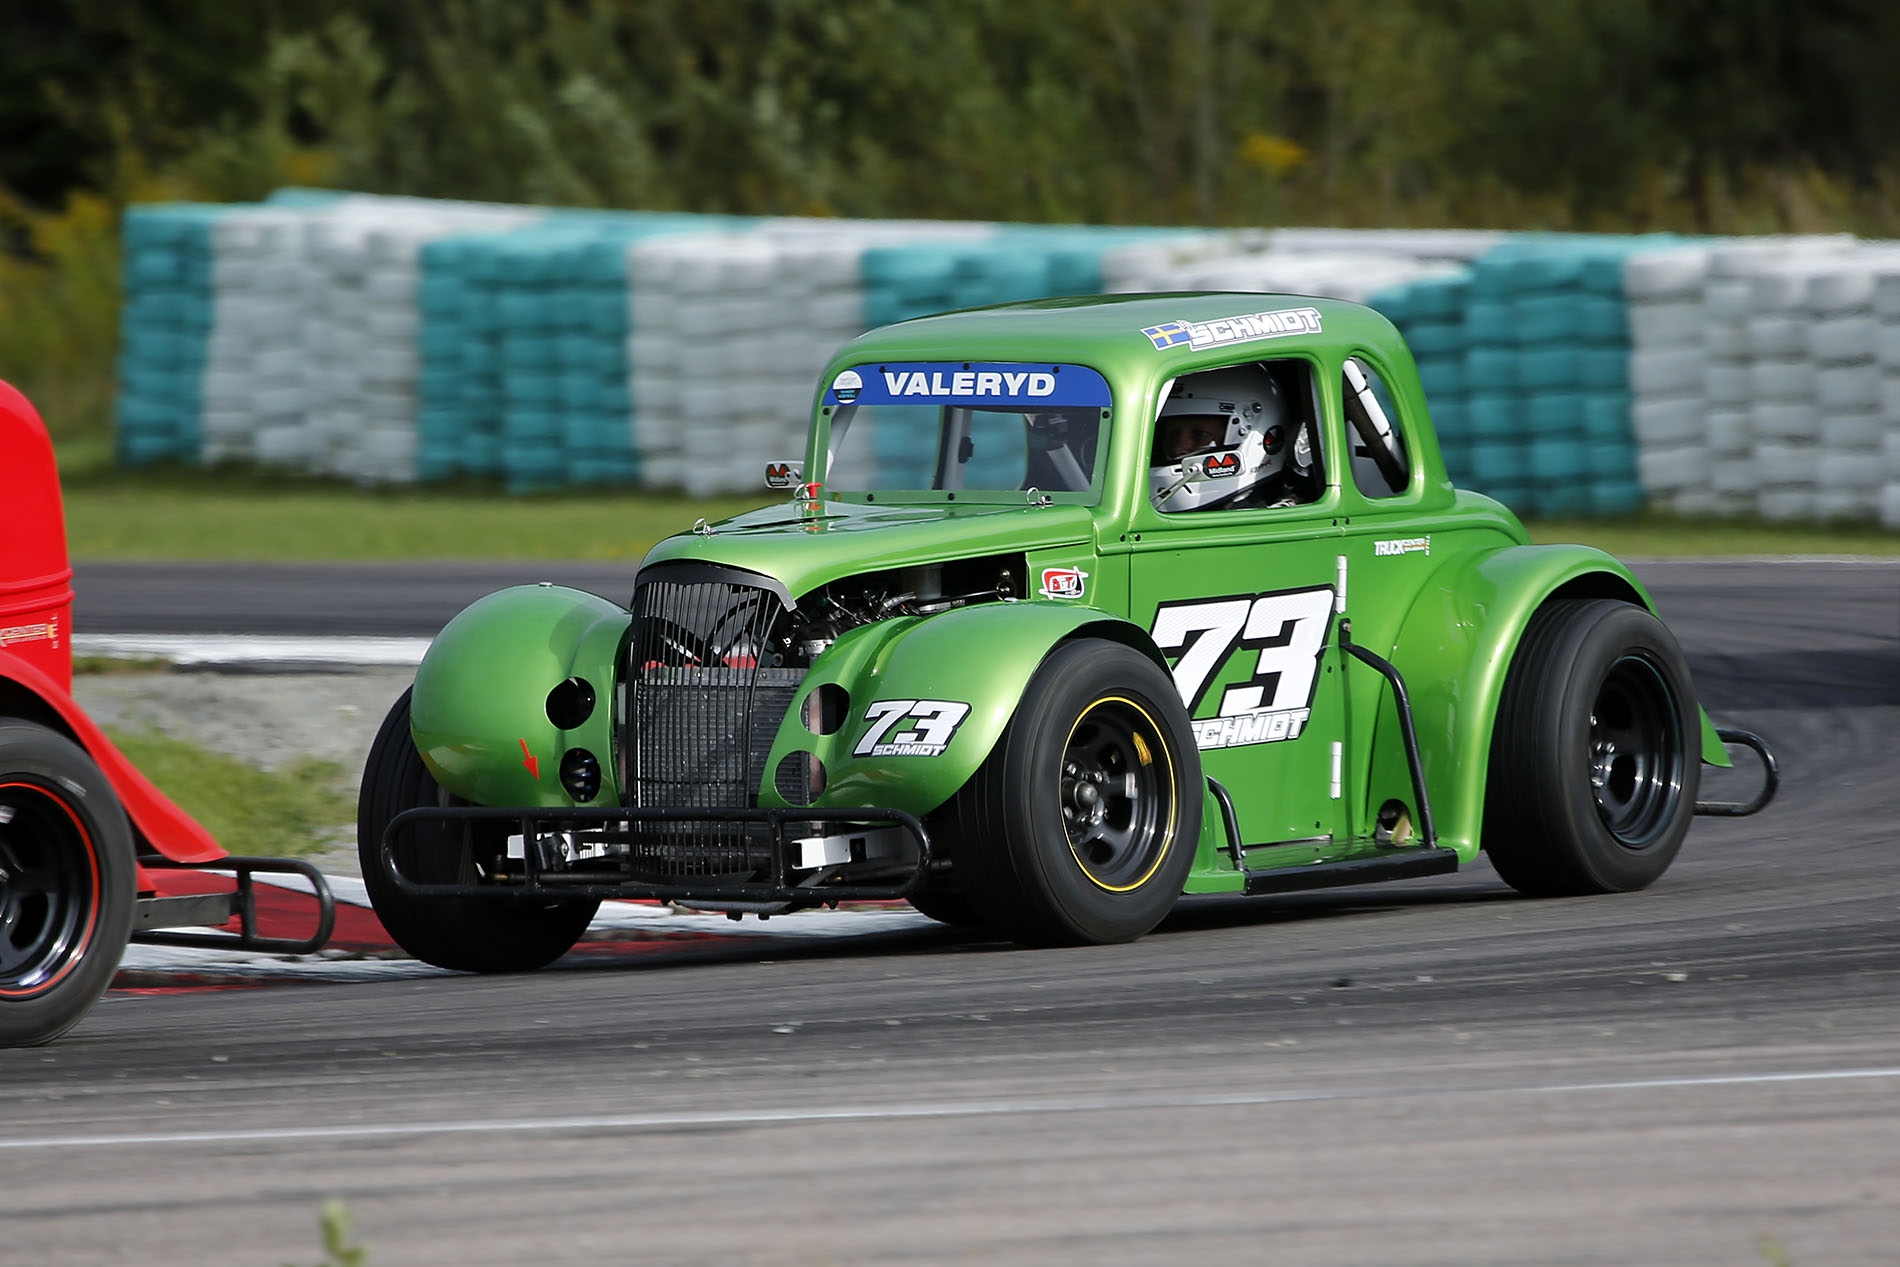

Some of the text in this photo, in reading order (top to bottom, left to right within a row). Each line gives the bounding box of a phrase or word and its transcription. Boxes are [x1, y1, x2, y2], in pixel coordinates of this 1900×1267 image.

[1189, 308, 1321, 350] SCHMIDT
[883, 371, 1056, 397] VALERYD
[1150, 585, 1336, 719] 73
[852, 699, 971, 757] 73
[872, 744, 947, 757] SCHMIDT
